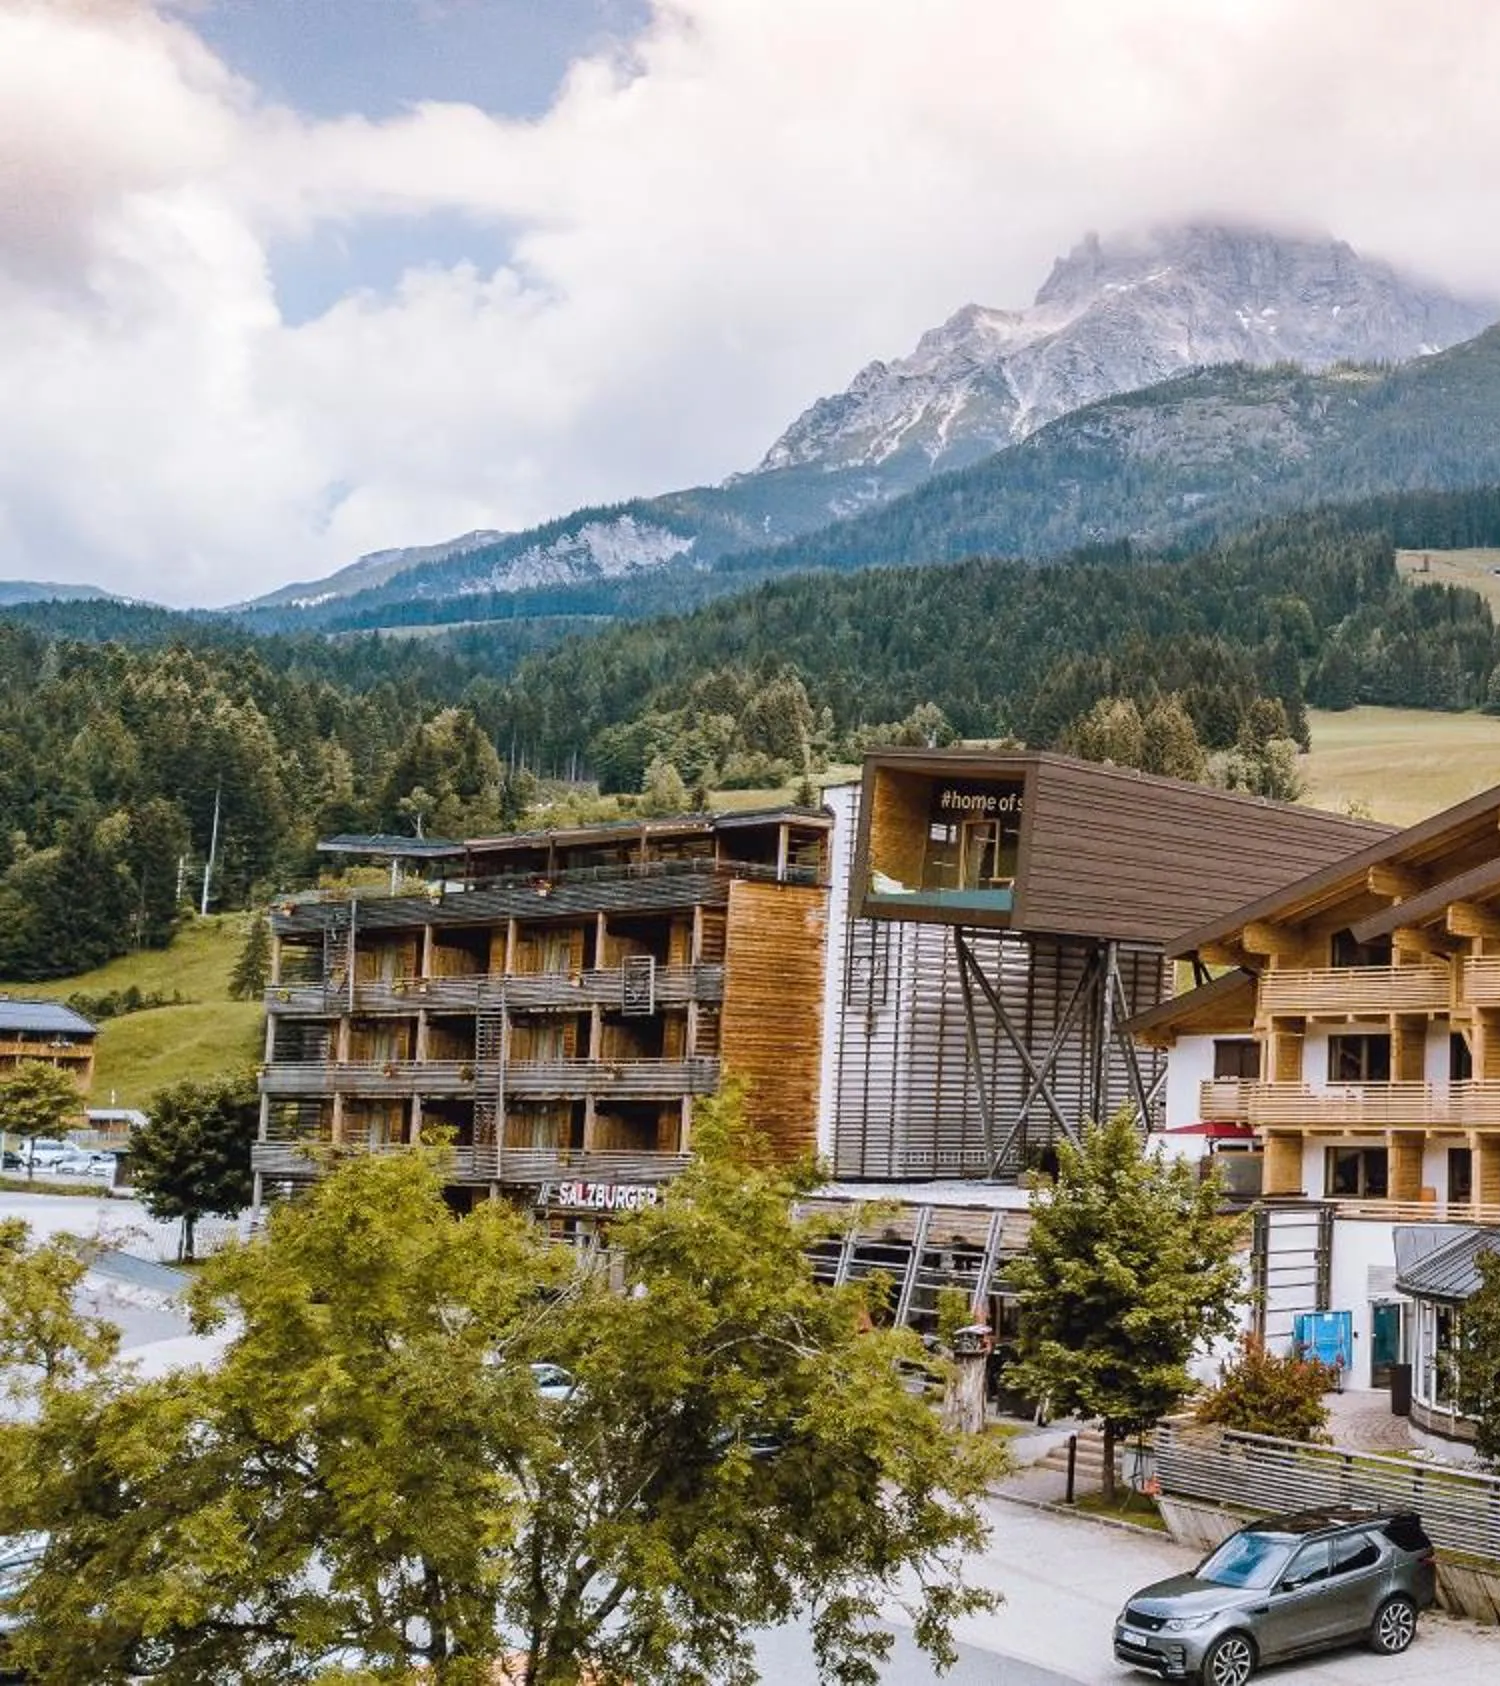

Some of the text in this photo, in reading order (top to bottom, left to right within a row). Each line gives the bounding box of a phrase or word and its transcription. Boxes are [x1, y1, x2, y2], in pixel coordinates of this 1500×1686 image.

[941, 790, 997, 810] #home
[999, 793, 1016, 812] of
[559, 1181, 657, 1210] SALZBURGER
